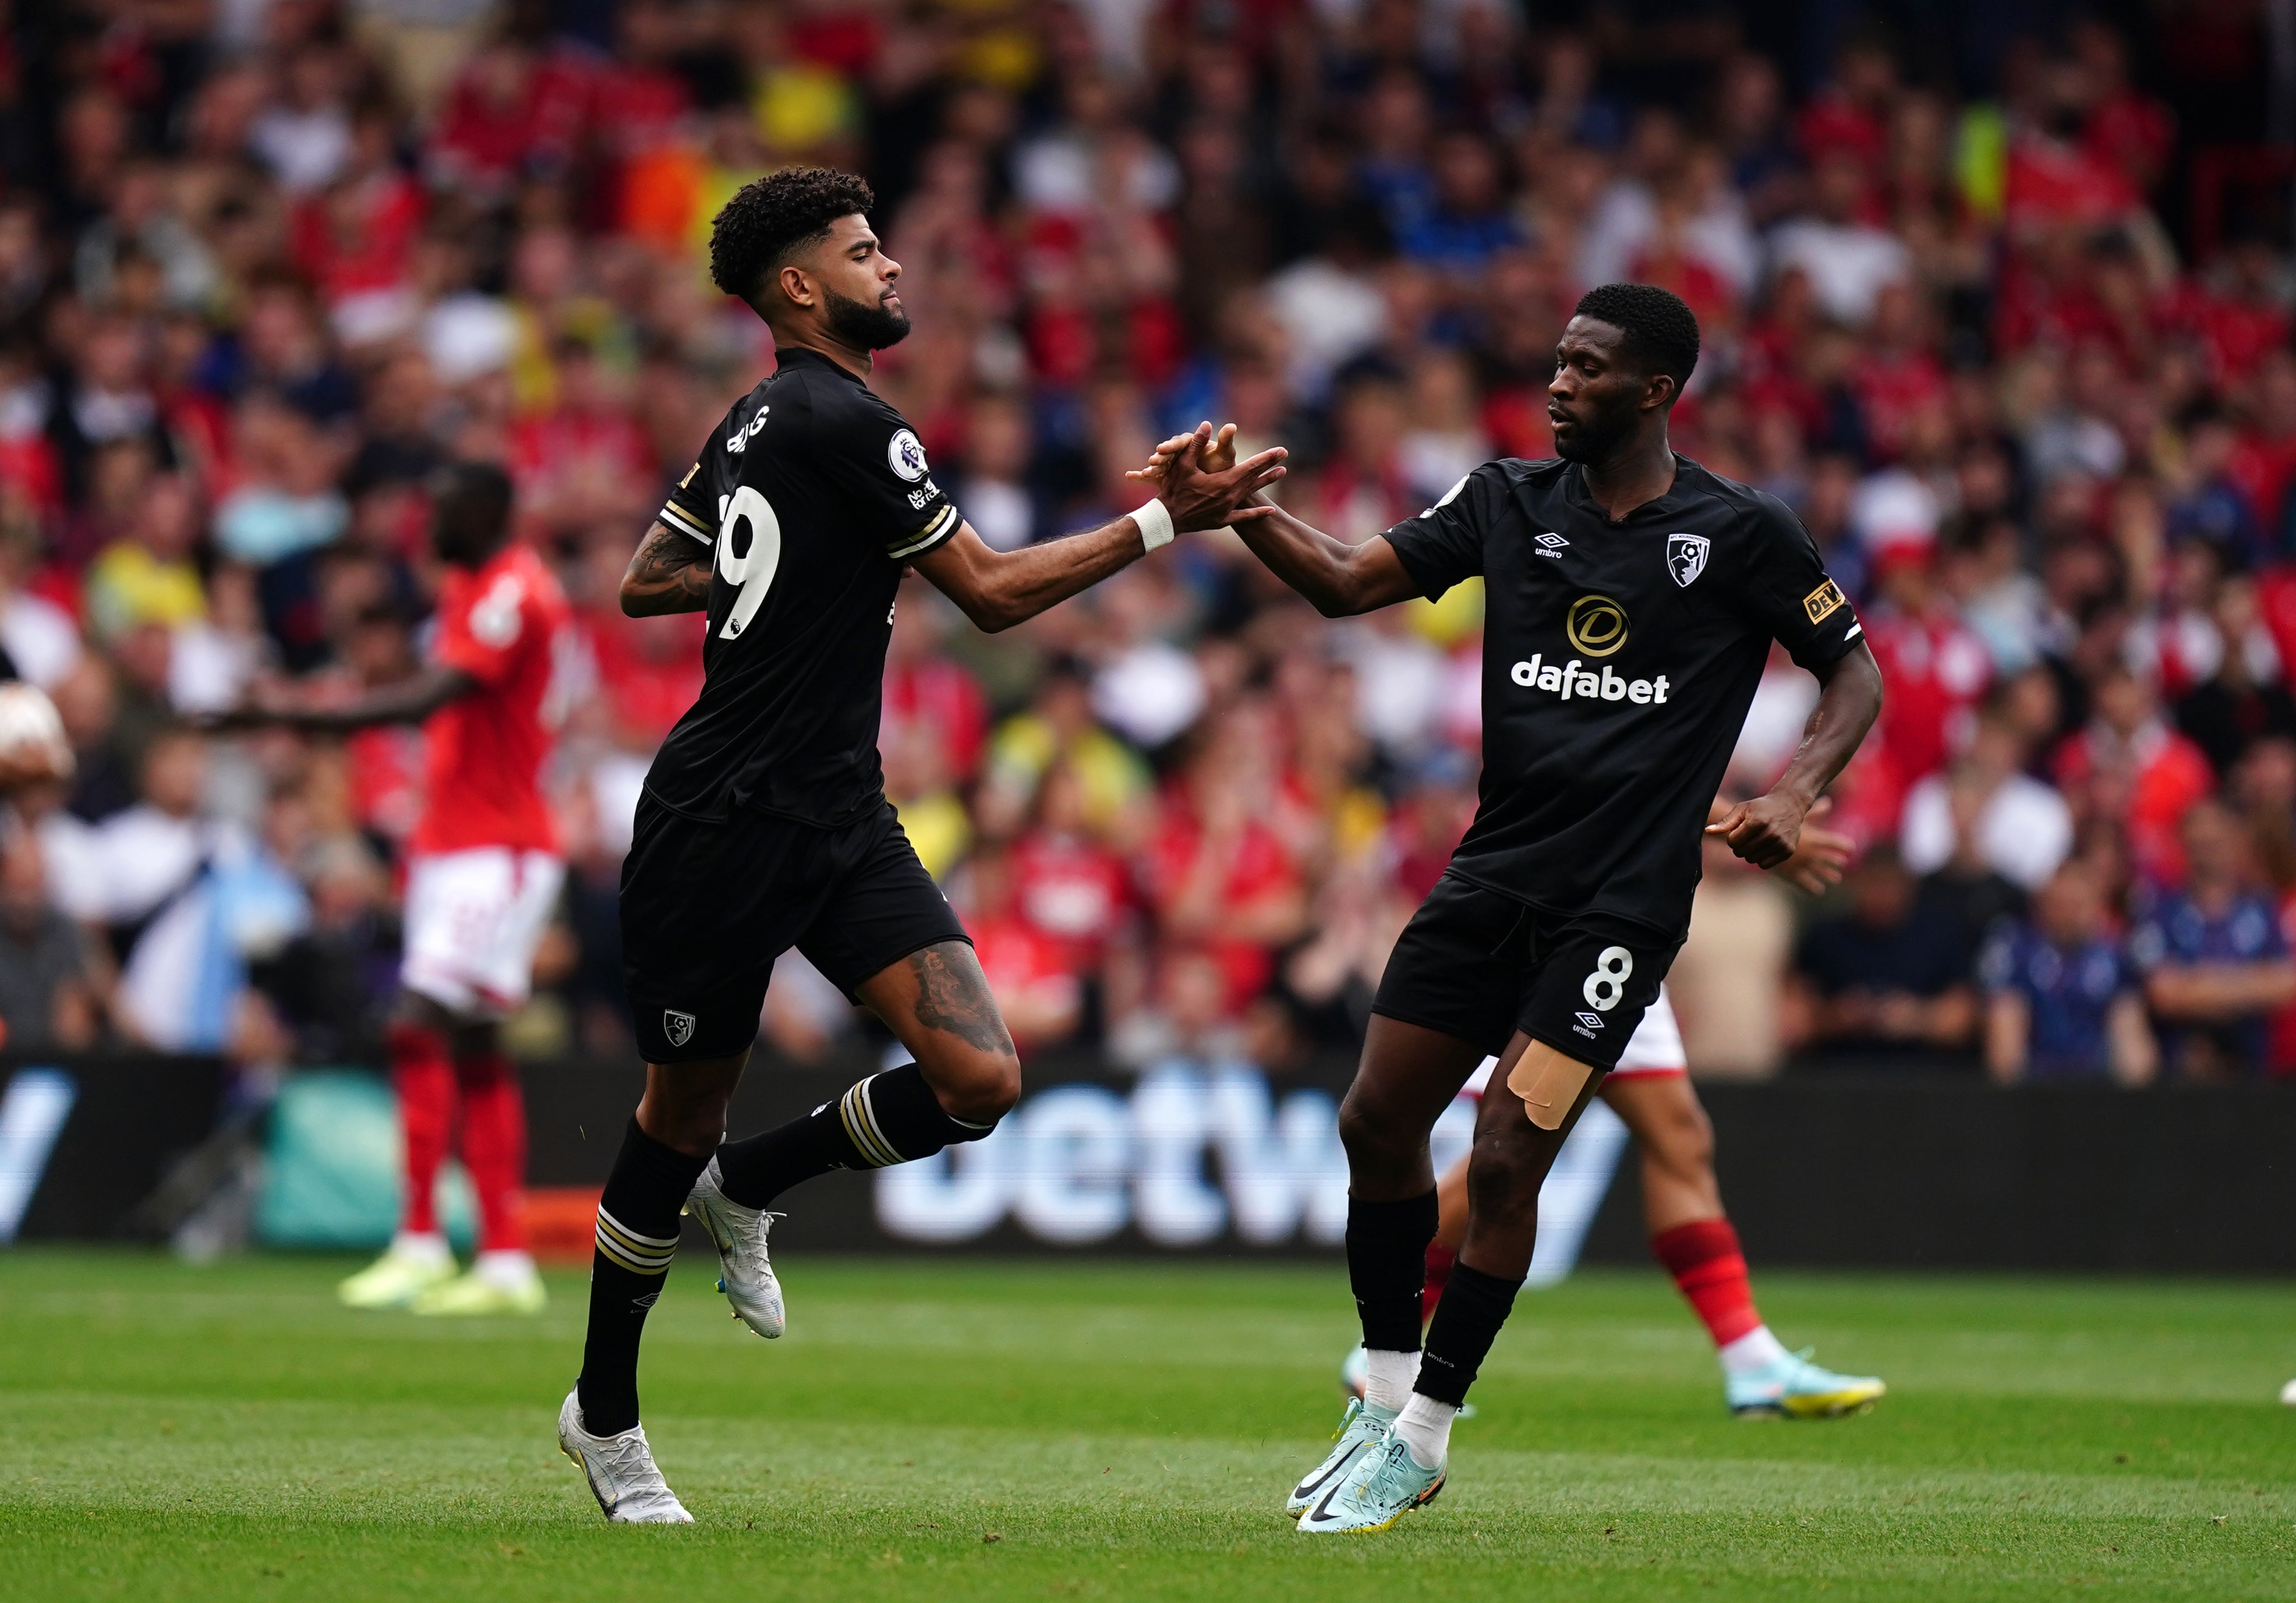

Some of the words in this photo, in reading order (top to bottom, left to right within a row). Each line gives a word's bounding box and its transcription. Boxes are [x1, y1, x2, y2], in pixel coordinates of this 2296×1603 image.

[907, 490, 922, 504] No
[912, 496, 926, 510] for
[1535, 548, 1562, 559] umbro
[1510, 653, 1670, 705] dafabet
[1583, 946, 1633, 1011] 8
[1572, 1024, 1596, 1040] umbro
[1427, 1351, 1455, 1368] umbro
